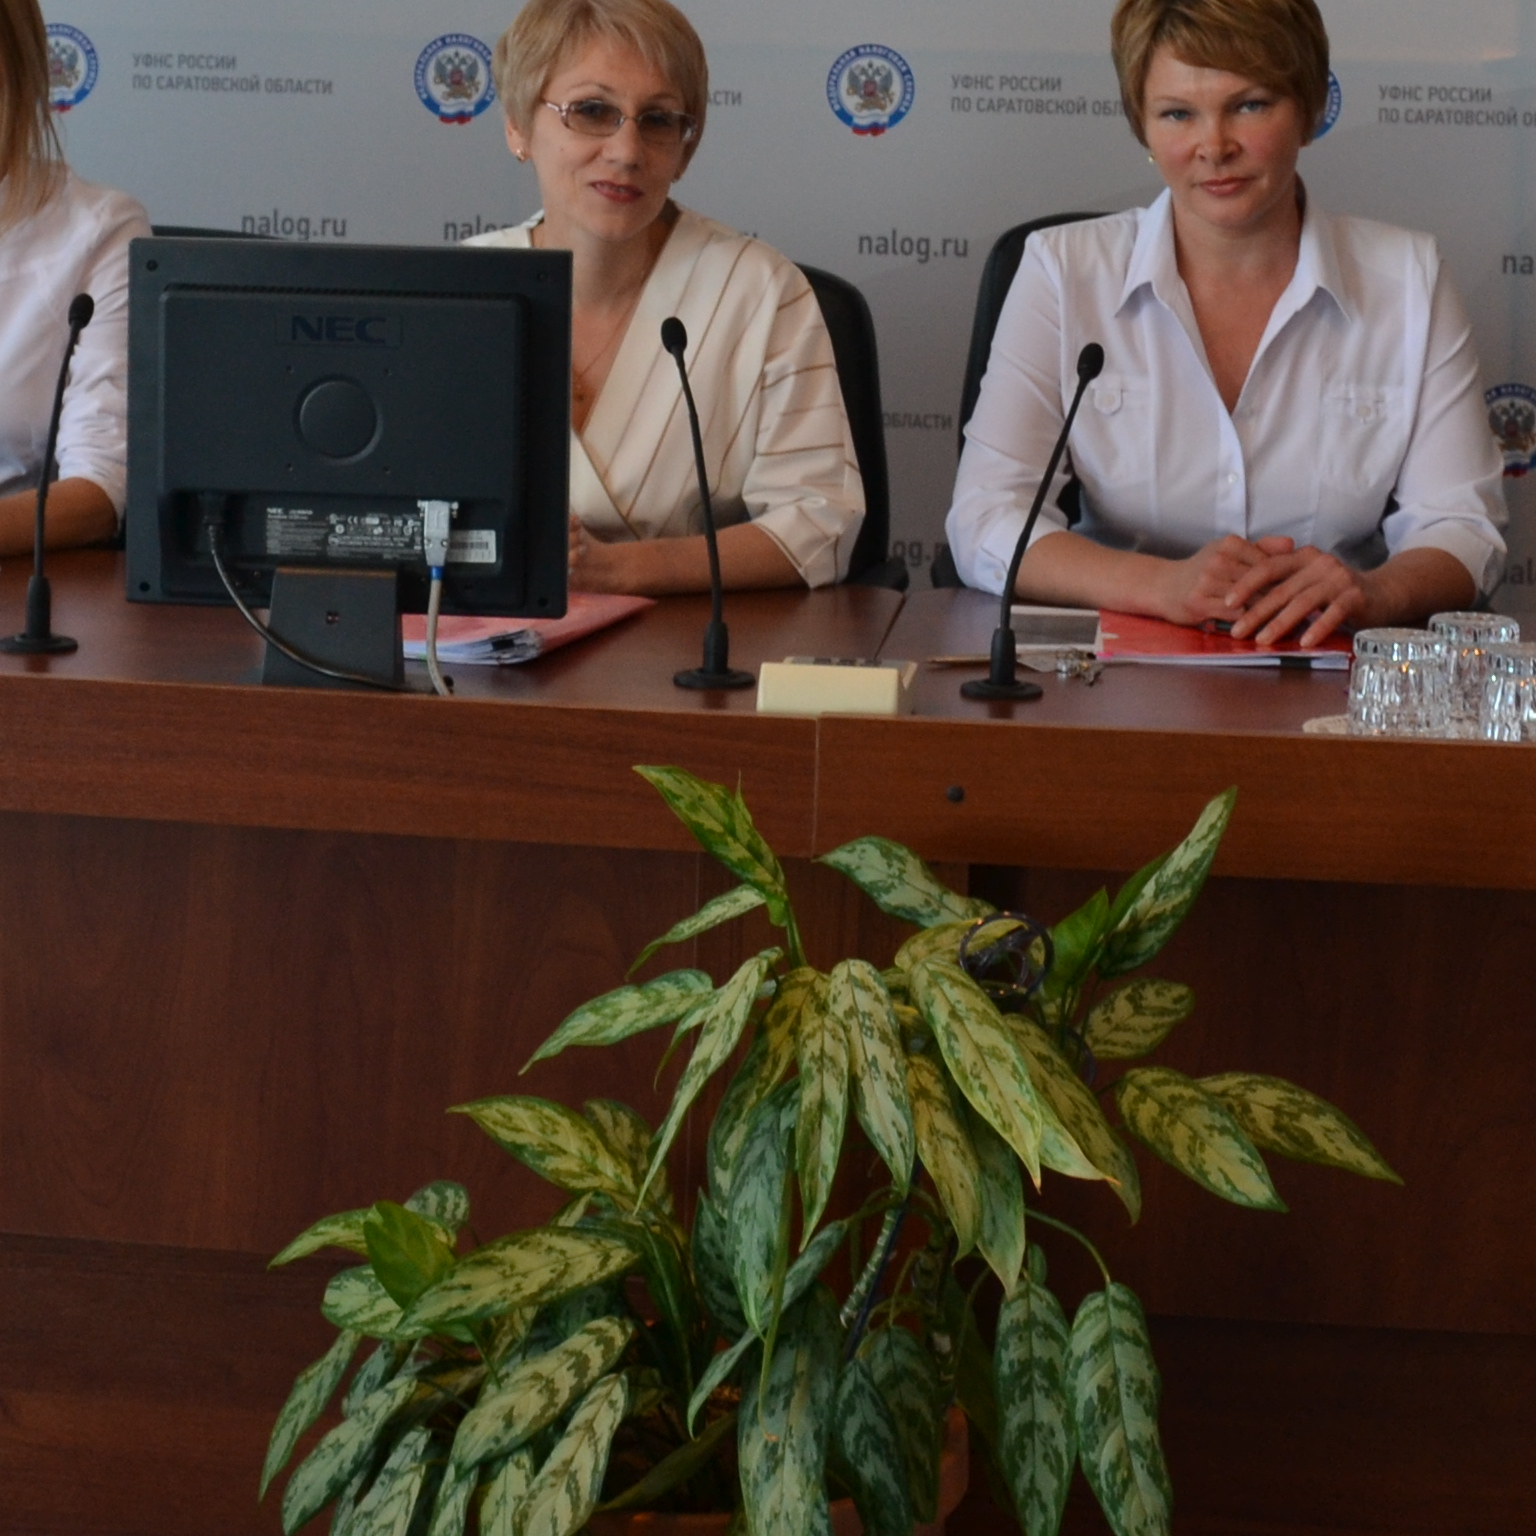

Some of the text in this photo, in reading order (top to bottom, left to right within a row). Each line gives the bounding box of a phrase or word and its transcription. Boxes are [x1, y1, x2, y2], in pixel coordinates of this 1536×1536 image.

[133, 53, 237, 70] УФНС РОССИИ
[132, 74, 333, 94] ПО САРАТОВСКОЙ ОБЛАСТИ
[952, 75, 1062, 92] УФНС РОССИИ
[1379, 85, 1493, 103] УФНС РОССИИ
[951, 96, 972, 113] ПО
[976, 97, 1087, 115] САРАТОВСКОЙ
[1378, 108, 1400, 124] ПО
[1404, 107, 1518, 127] САРАТОВСКОЙ
[238, 211, 350, 245] nalog.ru
[858, 229, 970, 266] nalog.ru
[290, 314, 386, 344] NEC
